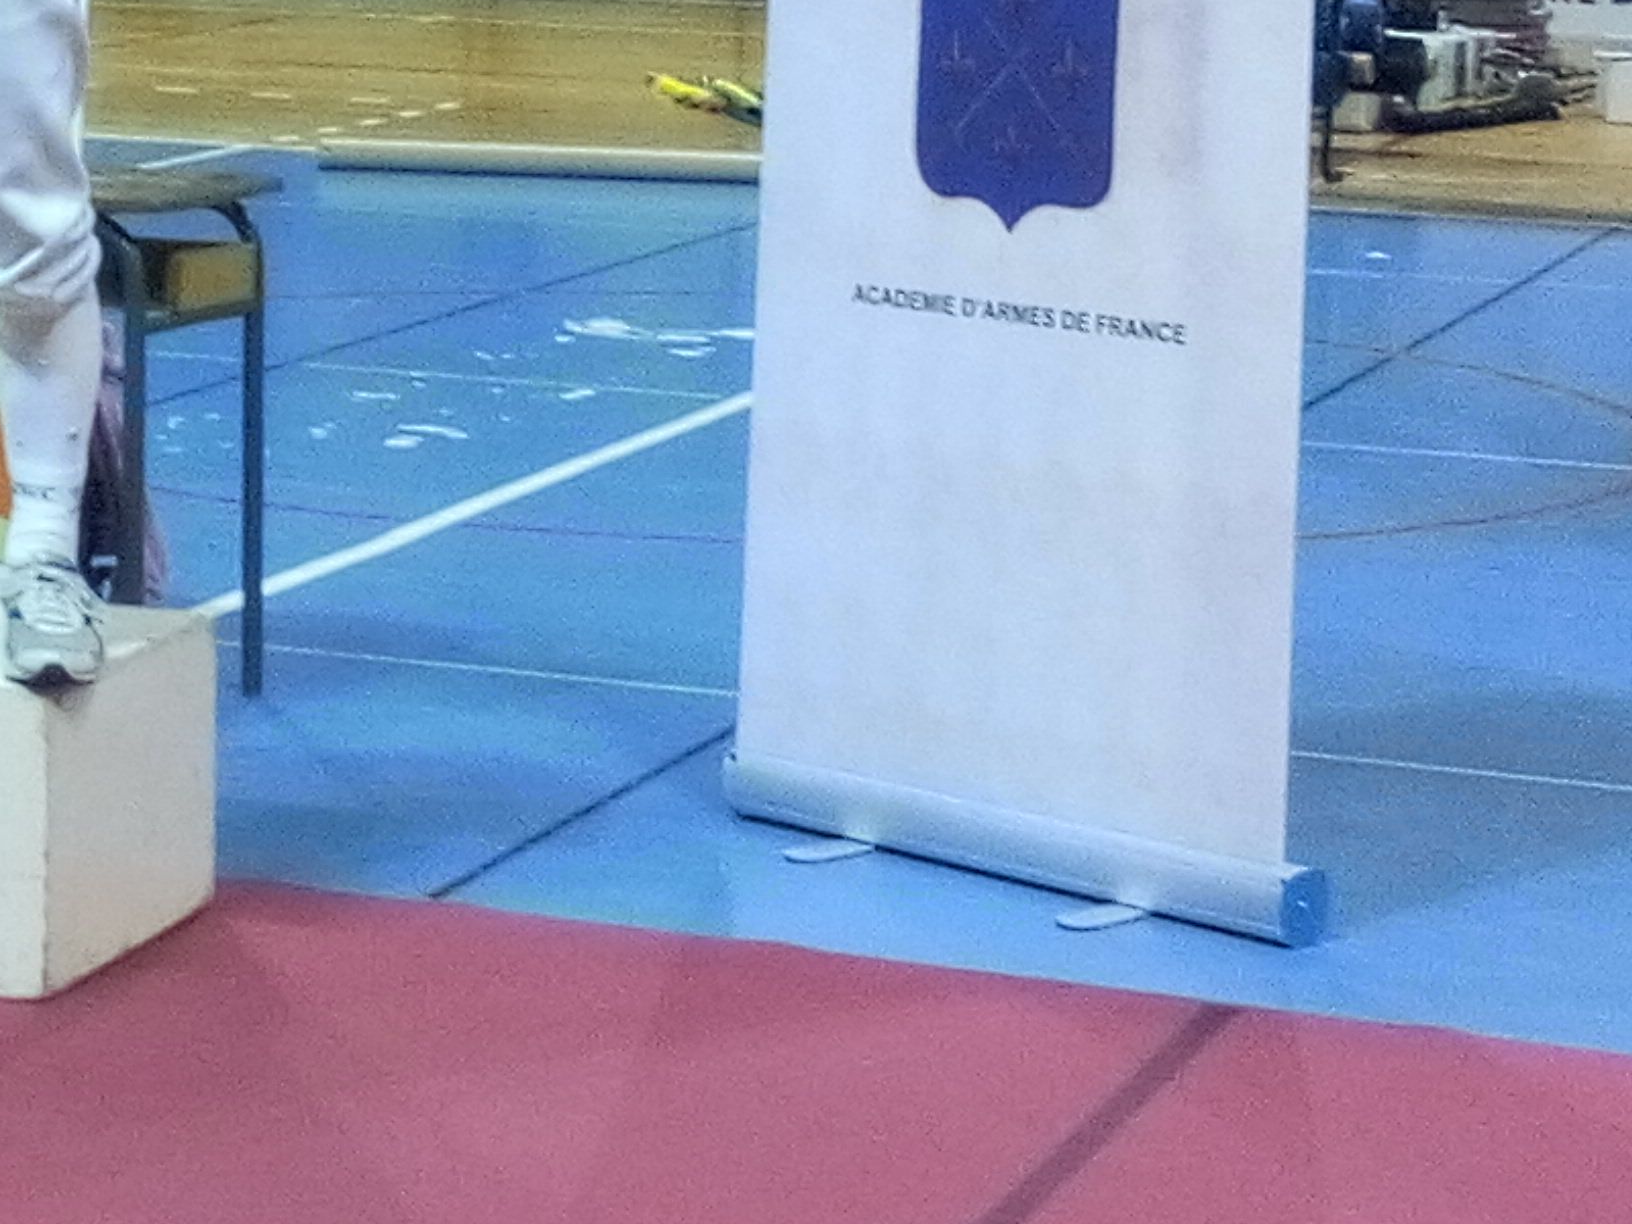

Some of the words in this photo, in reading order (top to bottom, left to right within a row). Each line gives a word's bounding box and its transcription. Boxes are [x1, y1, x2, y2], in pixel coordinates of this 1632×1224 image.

[852, 283, 956, 317] ACADEMIE
[961, 296, 1056, 329] D'ARMES
[1060, 309, 1091, 334] DE
[1095, 313, 1188, 346] FRANCE
